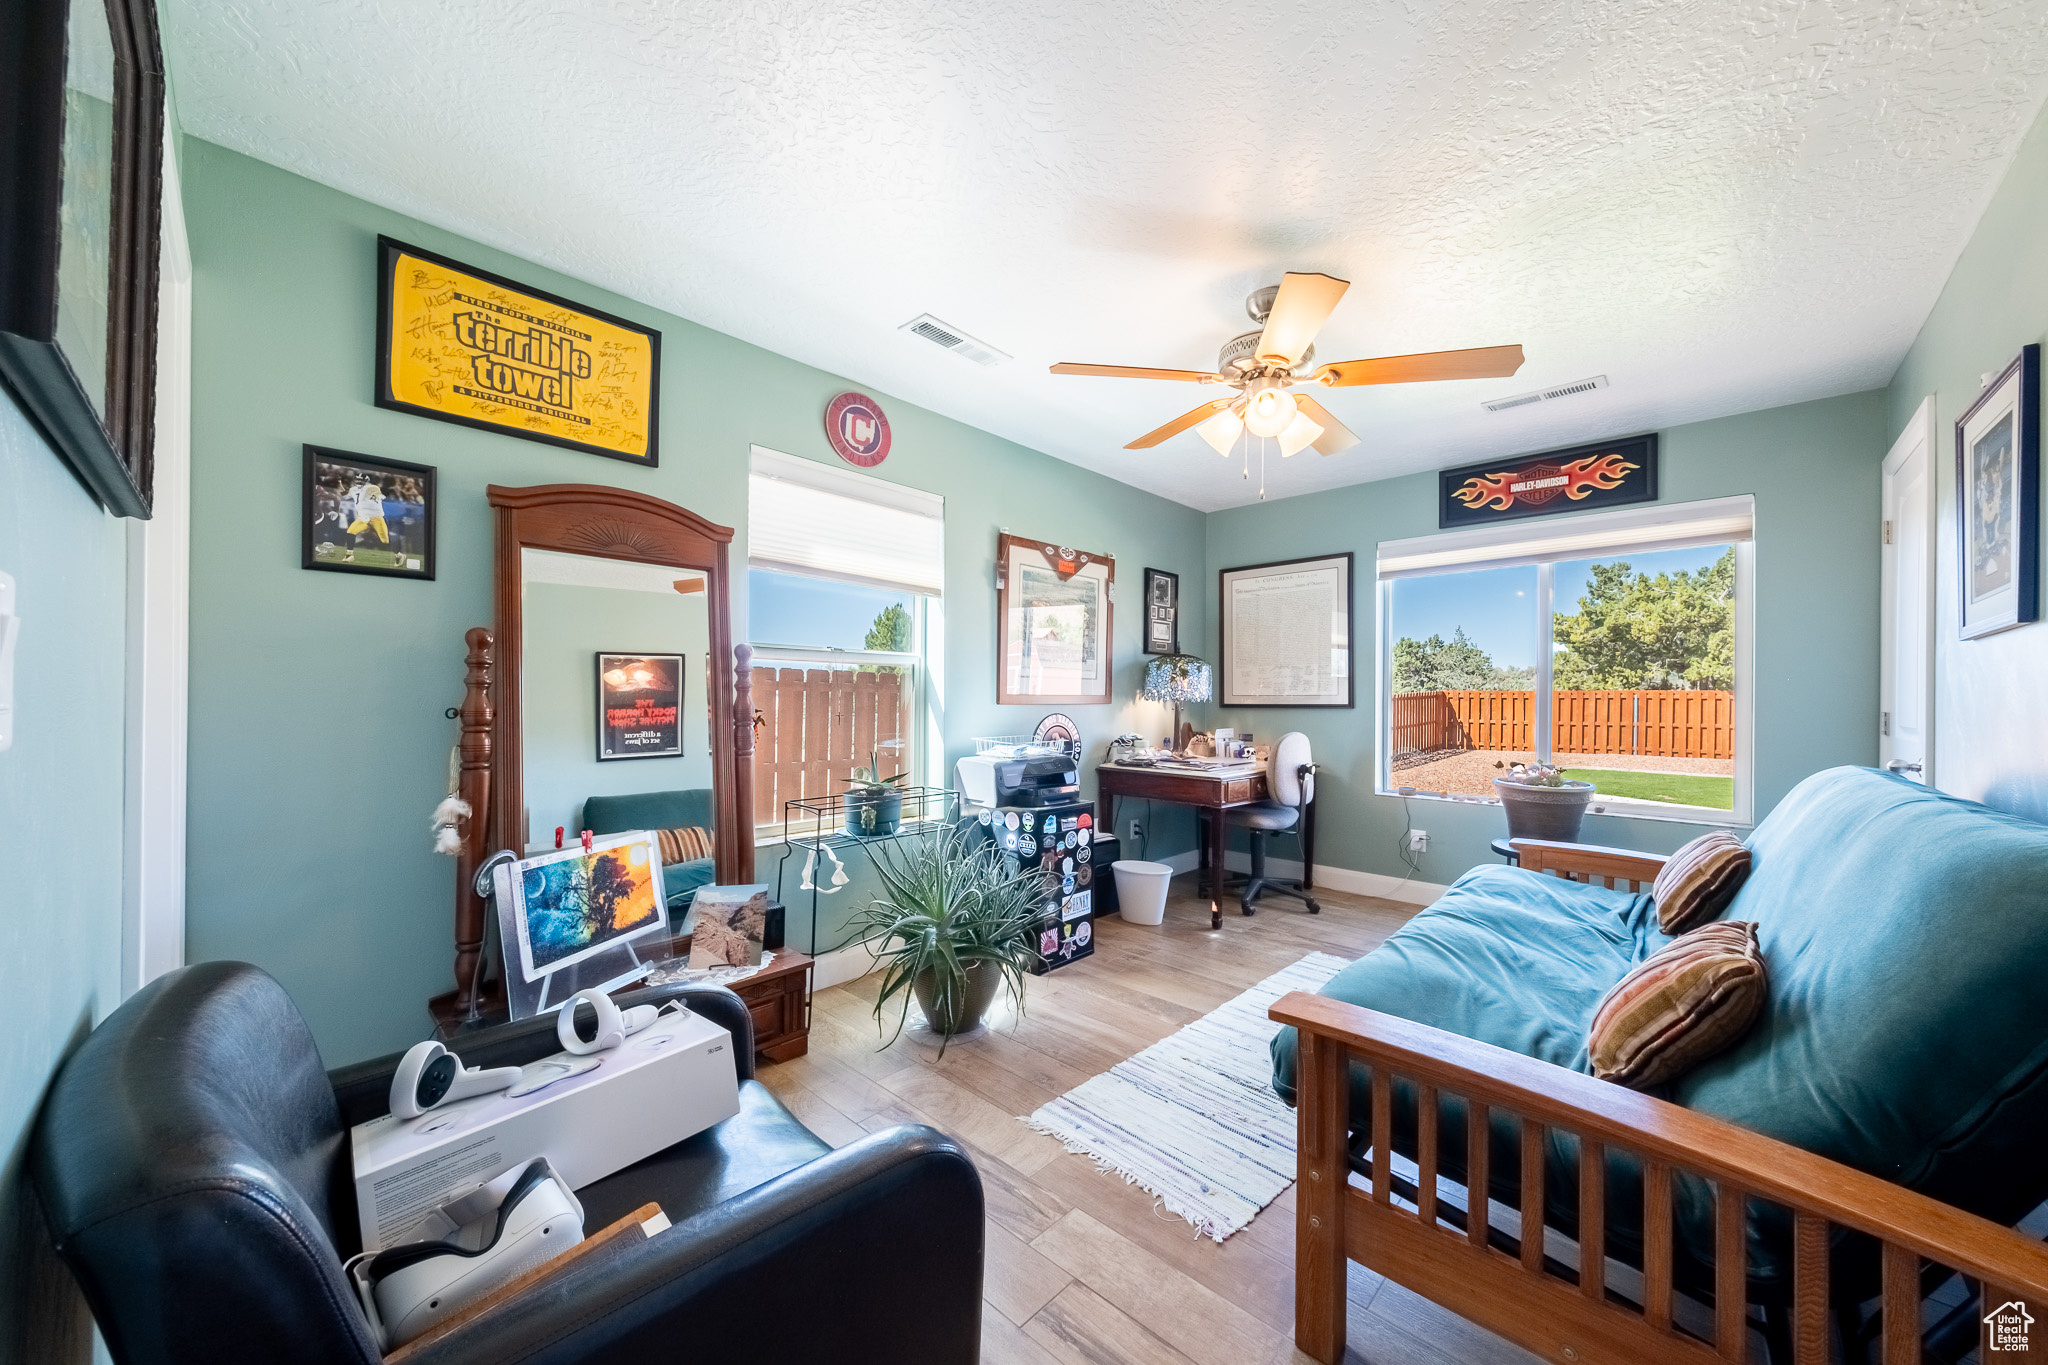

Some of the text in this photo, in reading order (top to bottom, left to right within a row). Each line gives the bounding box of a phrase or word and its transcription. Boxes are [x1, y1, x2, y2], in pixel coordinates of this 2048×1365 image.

[460, 294, 498, 311] MYRON
[502, 305, 538, 324] COPE'S
[543, 320, 587, 341] OFFICIAL
[475, 310, 501, 325] The
[453, 311, 592, 379] terrible
[471, 354, 573, 410] towel
[459, 387, 466, 396] A
[471, 391, 537, 412] PITTSBURGH
[541, 407, 588, 424] ORIGINAL
[833, 393, 888, 427] CLEVELAND
[835, 441, 884, 467] INDIANS
[1510, 475, 1569, 493] HARLEY-DAVIDSON
[1524, 468, 1554, 478] MOTOR
[1523, 488, 1556, 500] CYCLES
